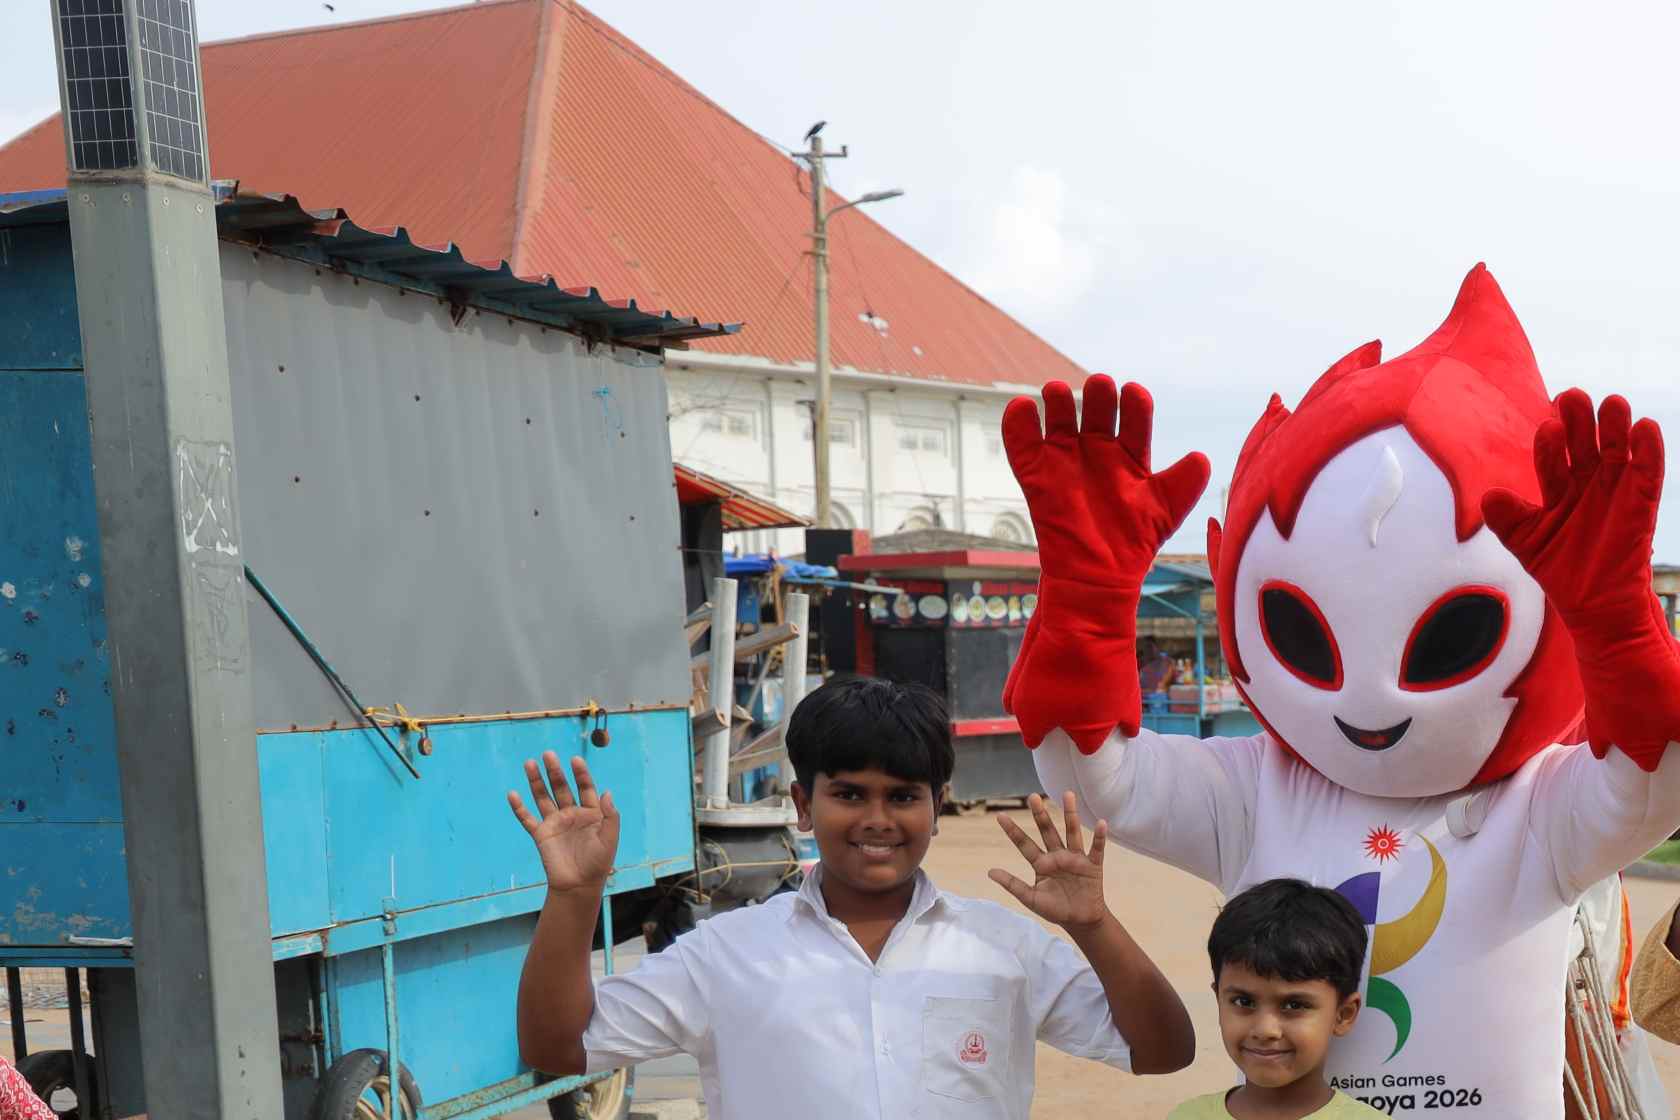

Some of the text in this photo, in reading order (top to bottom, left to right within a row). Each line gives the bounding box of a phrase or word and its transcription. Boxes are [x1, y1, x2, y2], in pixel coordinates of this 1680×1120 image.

[1329, 1074, 1446, 1089] Asian Games
[1423, 1088, 1483, 1109] 2026
